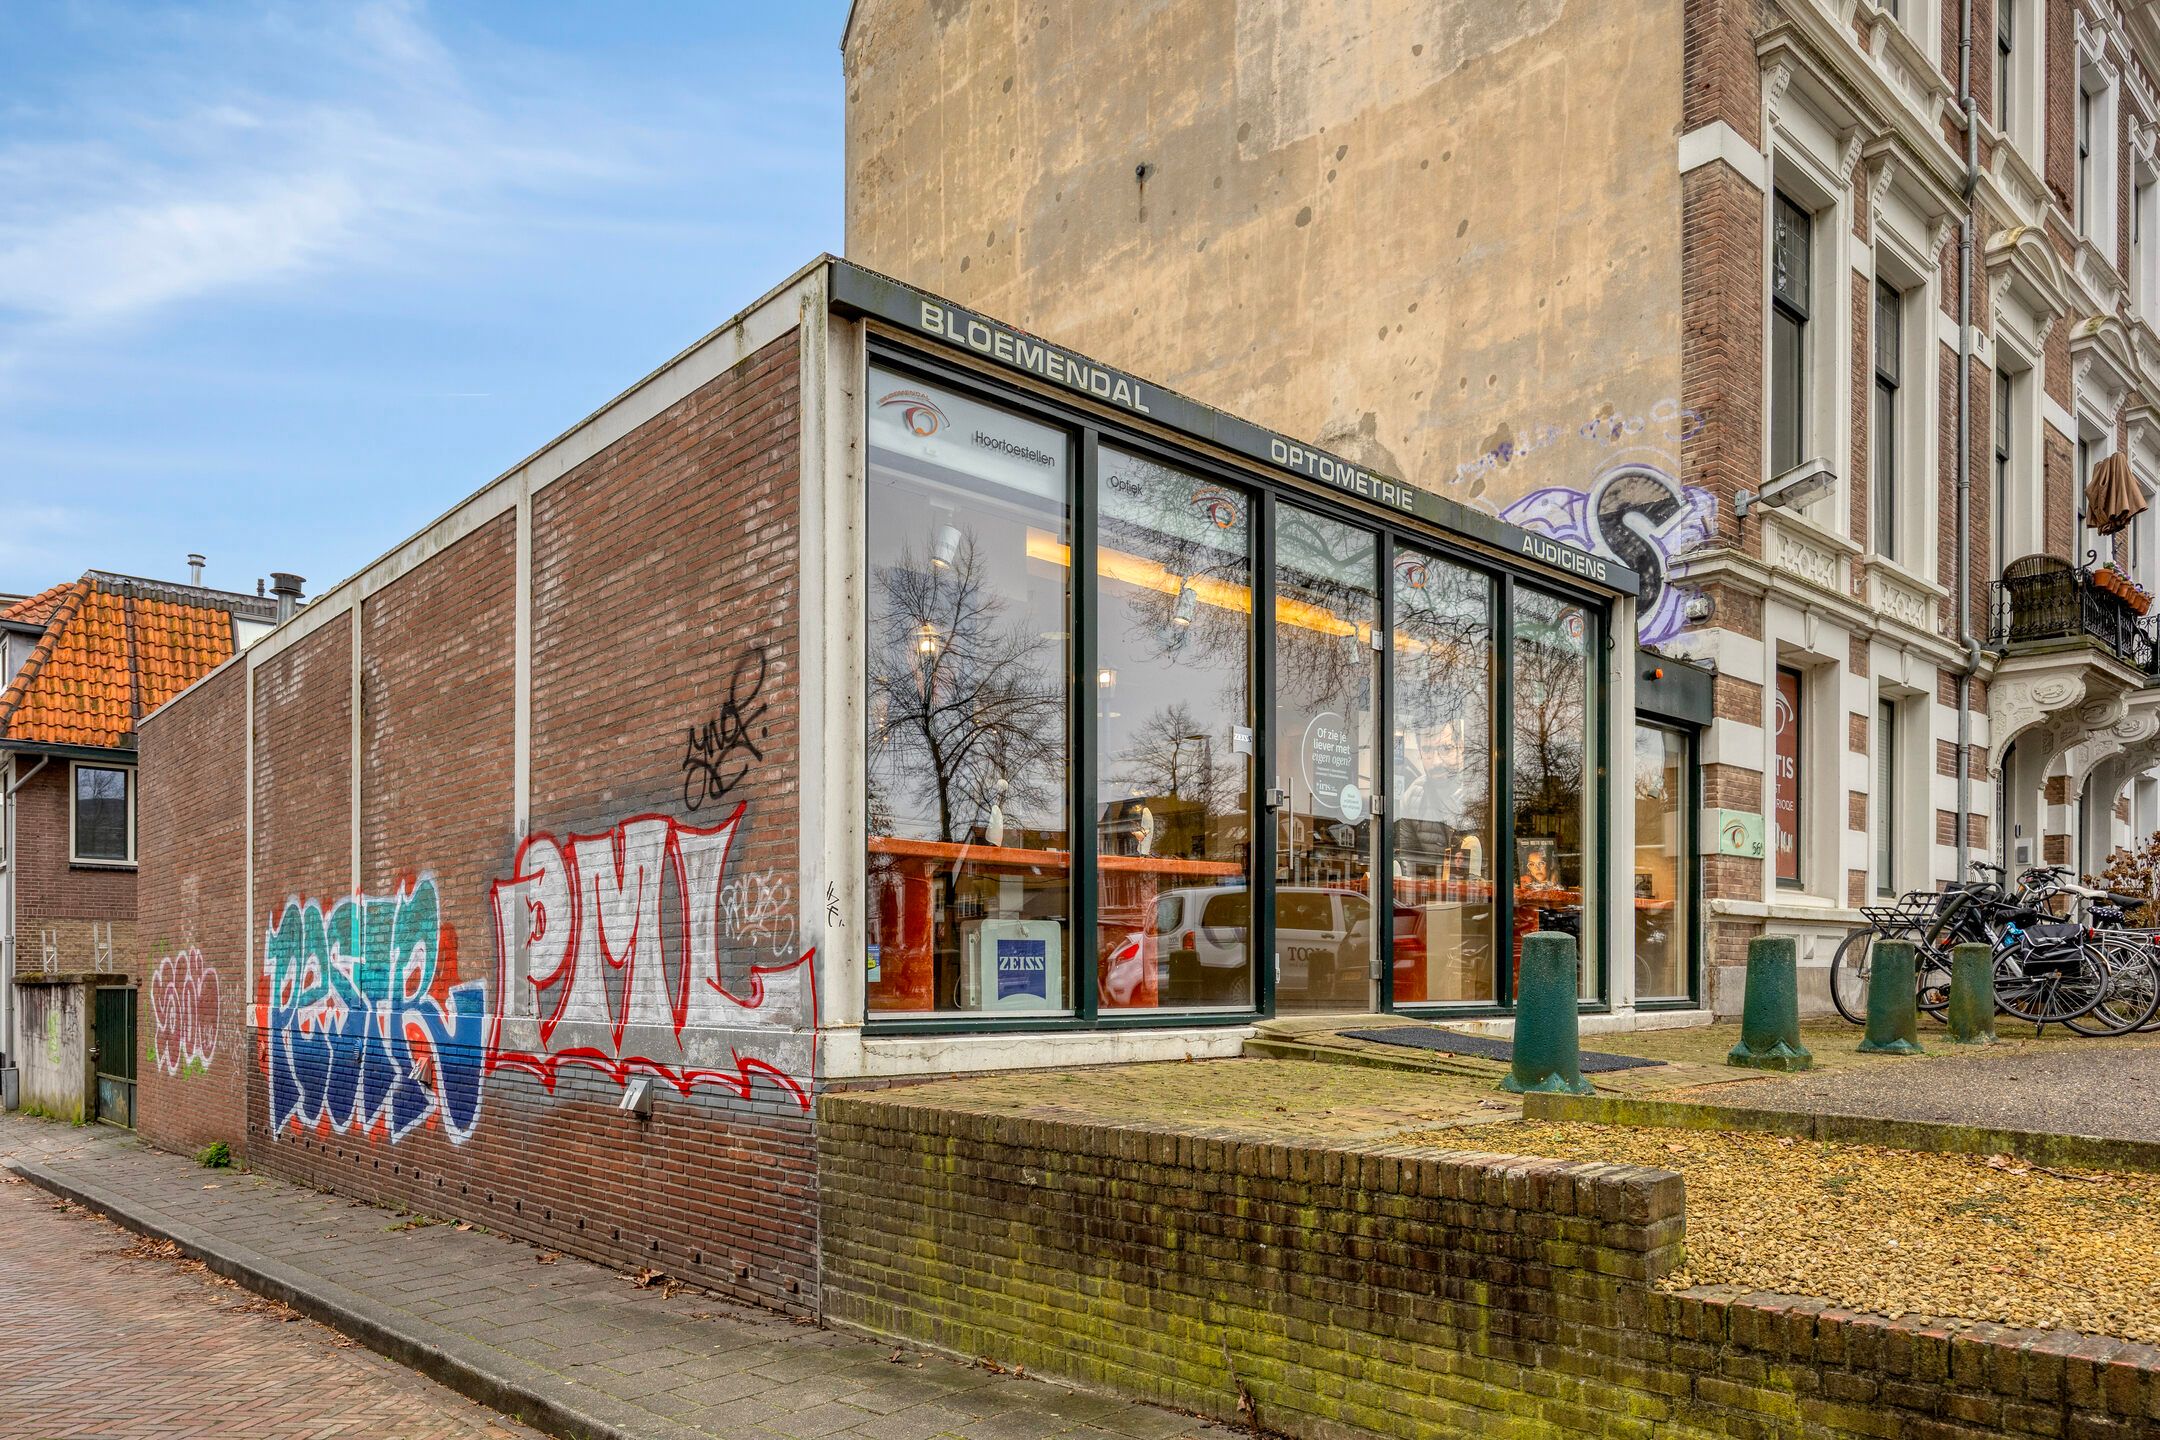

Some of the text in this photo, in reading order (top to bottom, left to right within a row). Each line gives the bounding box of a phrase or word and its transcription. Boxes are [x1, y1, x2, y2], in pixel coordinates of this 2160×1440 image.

[921, 300, 1150, 414] BLOEMENDAL
[975, 430, 1056, 468] Hoortoestellen
[1110, 475, 1144, 497] Optiek
[1271, 438, 1413, 512] OPTOMETRIE
[1522, 535, 1606, 581] AUDICIENS
[1313, 738, 1350, 755] liever met
[1317, 727, 1347, 744] Of zie je
[1312, 750, 1352, 768] eigen ogen?
[1775, 754, 1794, 779] TIS
[999, 956, 1044, 971] ZEISS
